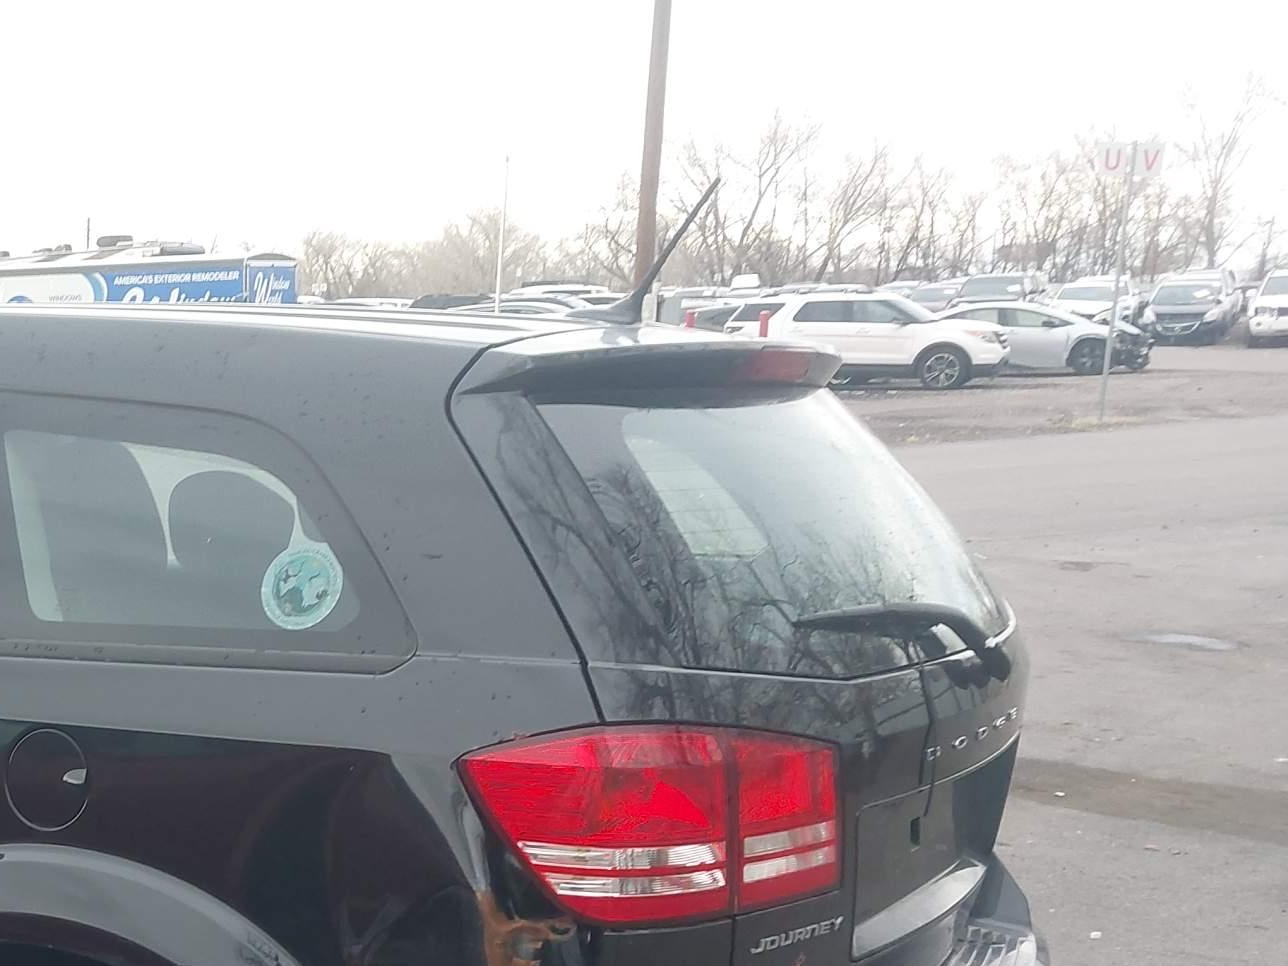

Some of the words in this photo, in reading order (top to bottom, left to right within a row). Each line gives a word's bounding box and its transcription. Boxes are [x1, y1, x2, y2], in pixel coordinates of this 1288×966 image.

[1105, 148, 1121, 171] U
[1143, 148, 1160, 171] V
[114, 274, 153, 286] AMERICA'S
[154, 273, 191, 284] EXTERIOR
[192, 270, 240, 282] REMODELER
[926, 706, 1018, 761] DODGE
[750, 916, 844, 954] JOURNEY
